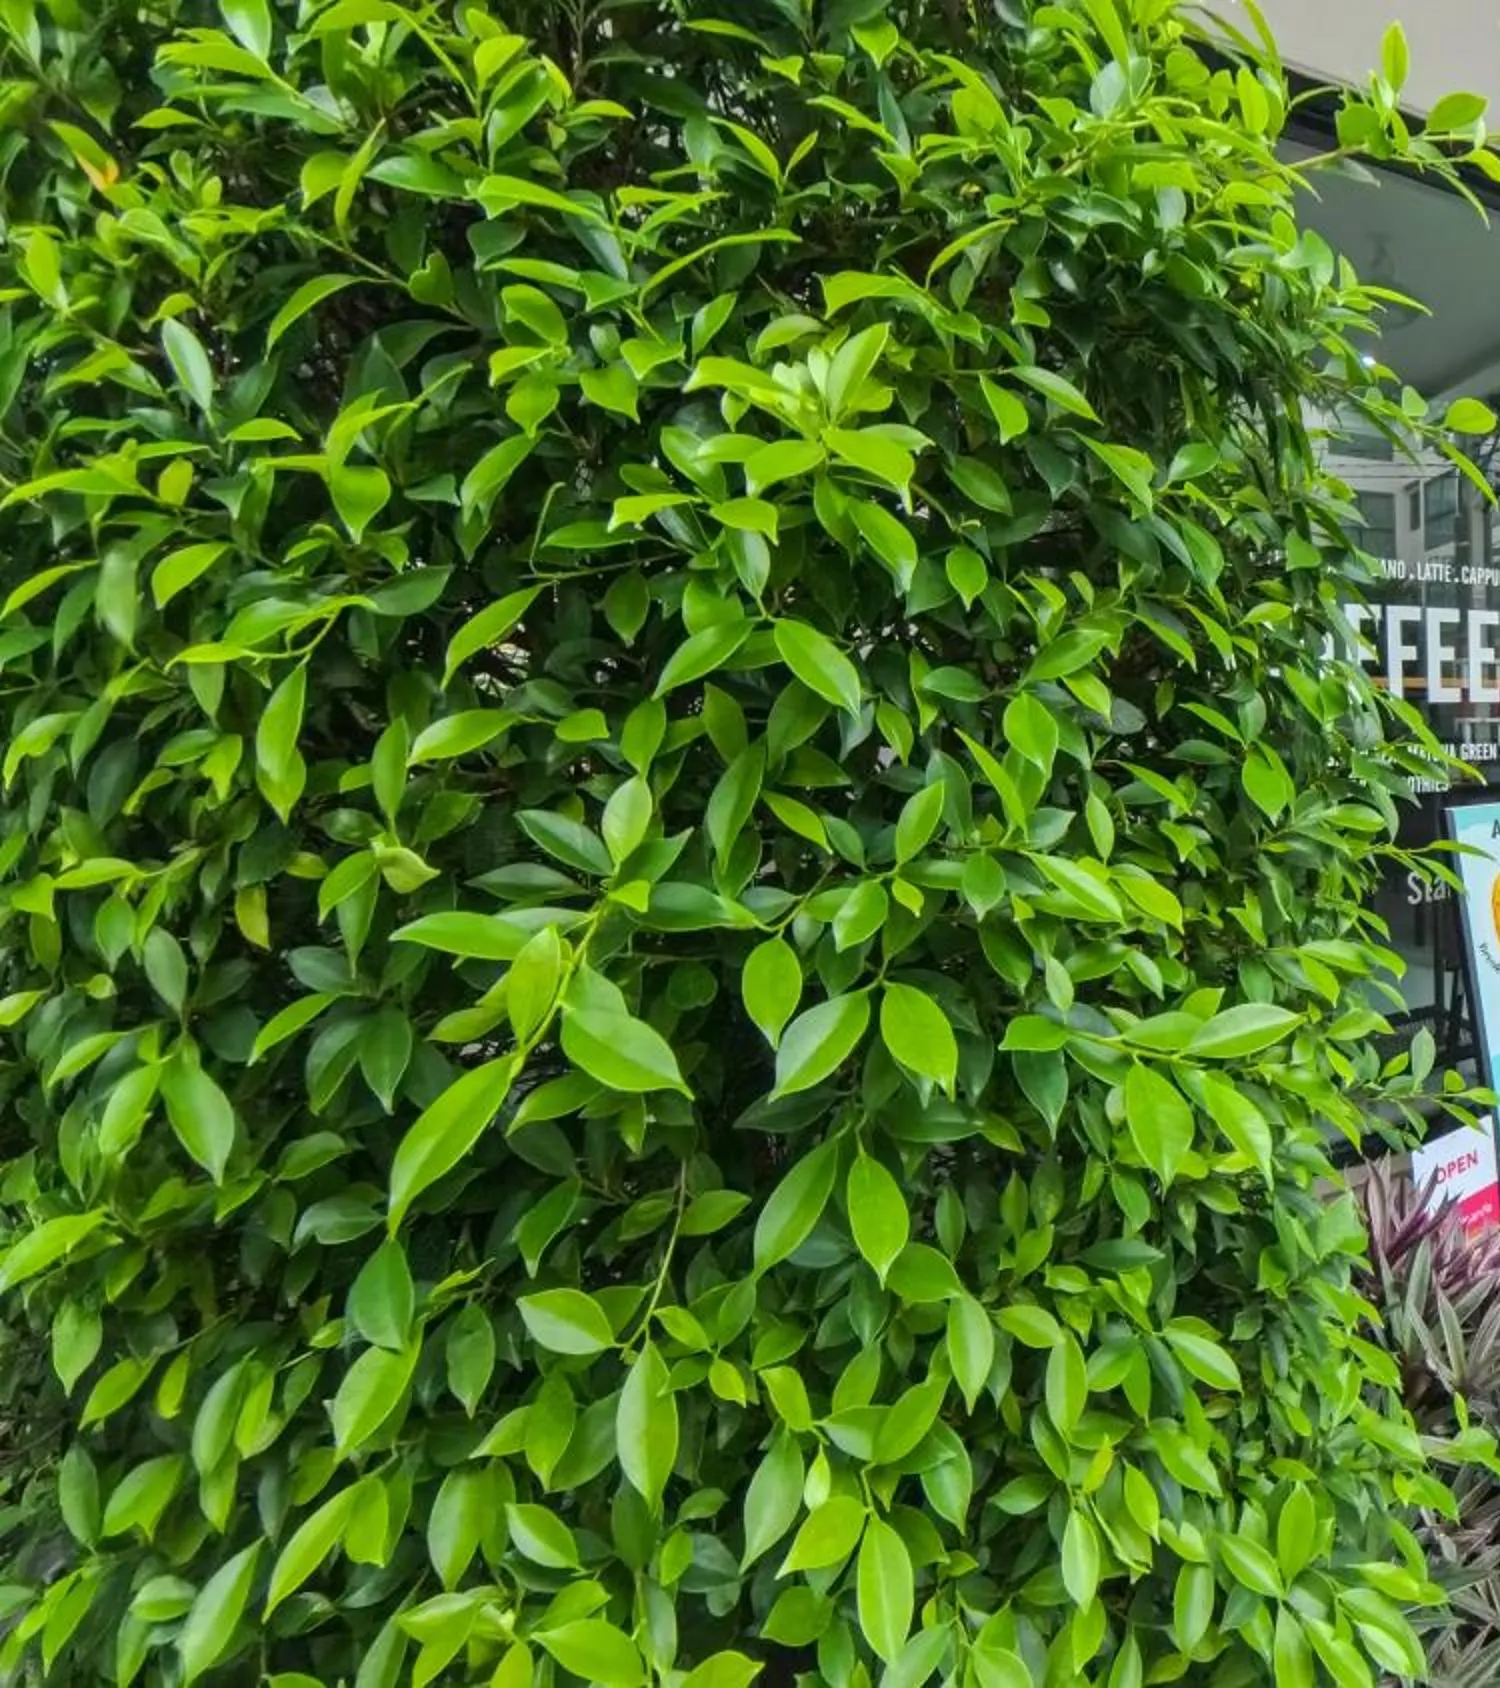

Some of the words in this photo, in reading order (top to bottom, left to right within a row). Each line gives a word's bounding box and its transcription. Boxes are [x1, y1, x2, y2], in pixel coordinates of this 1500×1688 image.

[1417, 561, 1453, 583] LATTE
[1460, 743, 1497, 761] GREEN
[1435, 1149, 1479, 1185] OPEN
